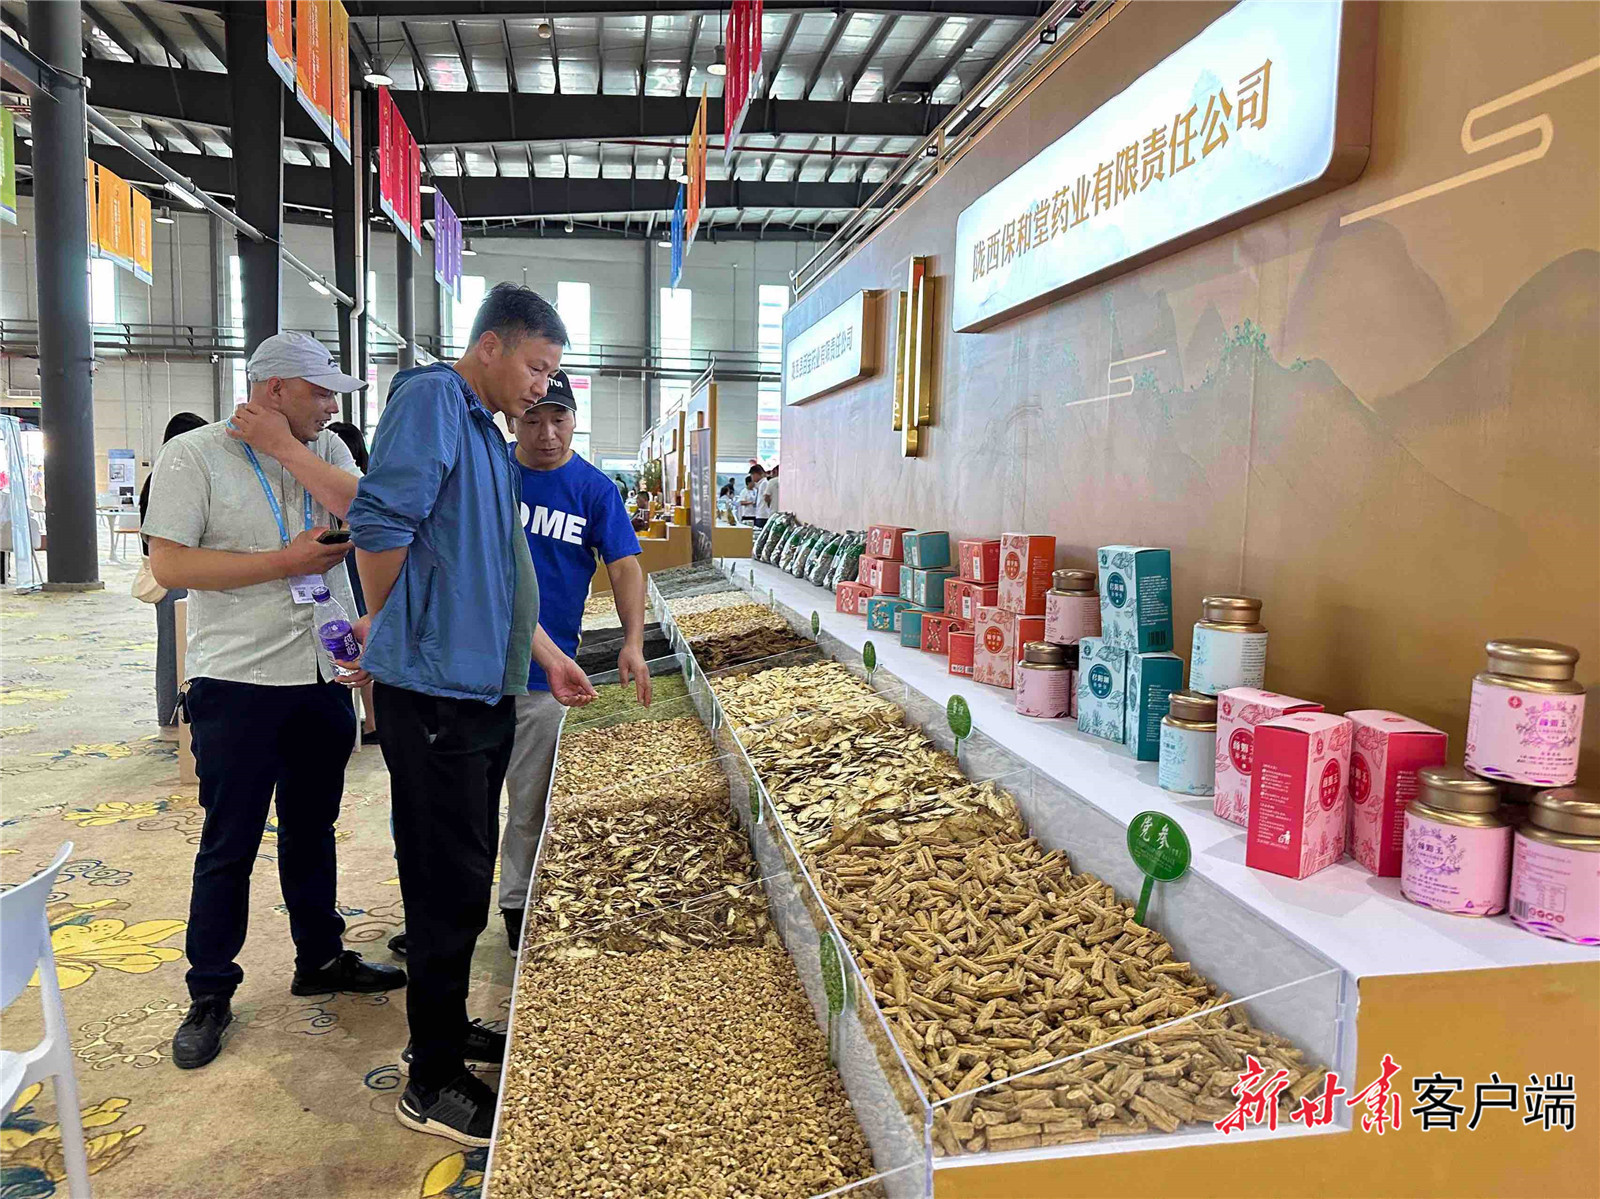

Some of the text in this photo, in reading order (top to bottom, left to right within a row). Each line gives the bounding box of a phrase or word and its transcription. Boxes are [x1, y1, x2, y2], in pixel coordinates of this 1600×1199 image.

[972, 58, 1272, 282] 陇西保和堂药业有限责任公司
[1139, 815, 1170, 850] 党参
